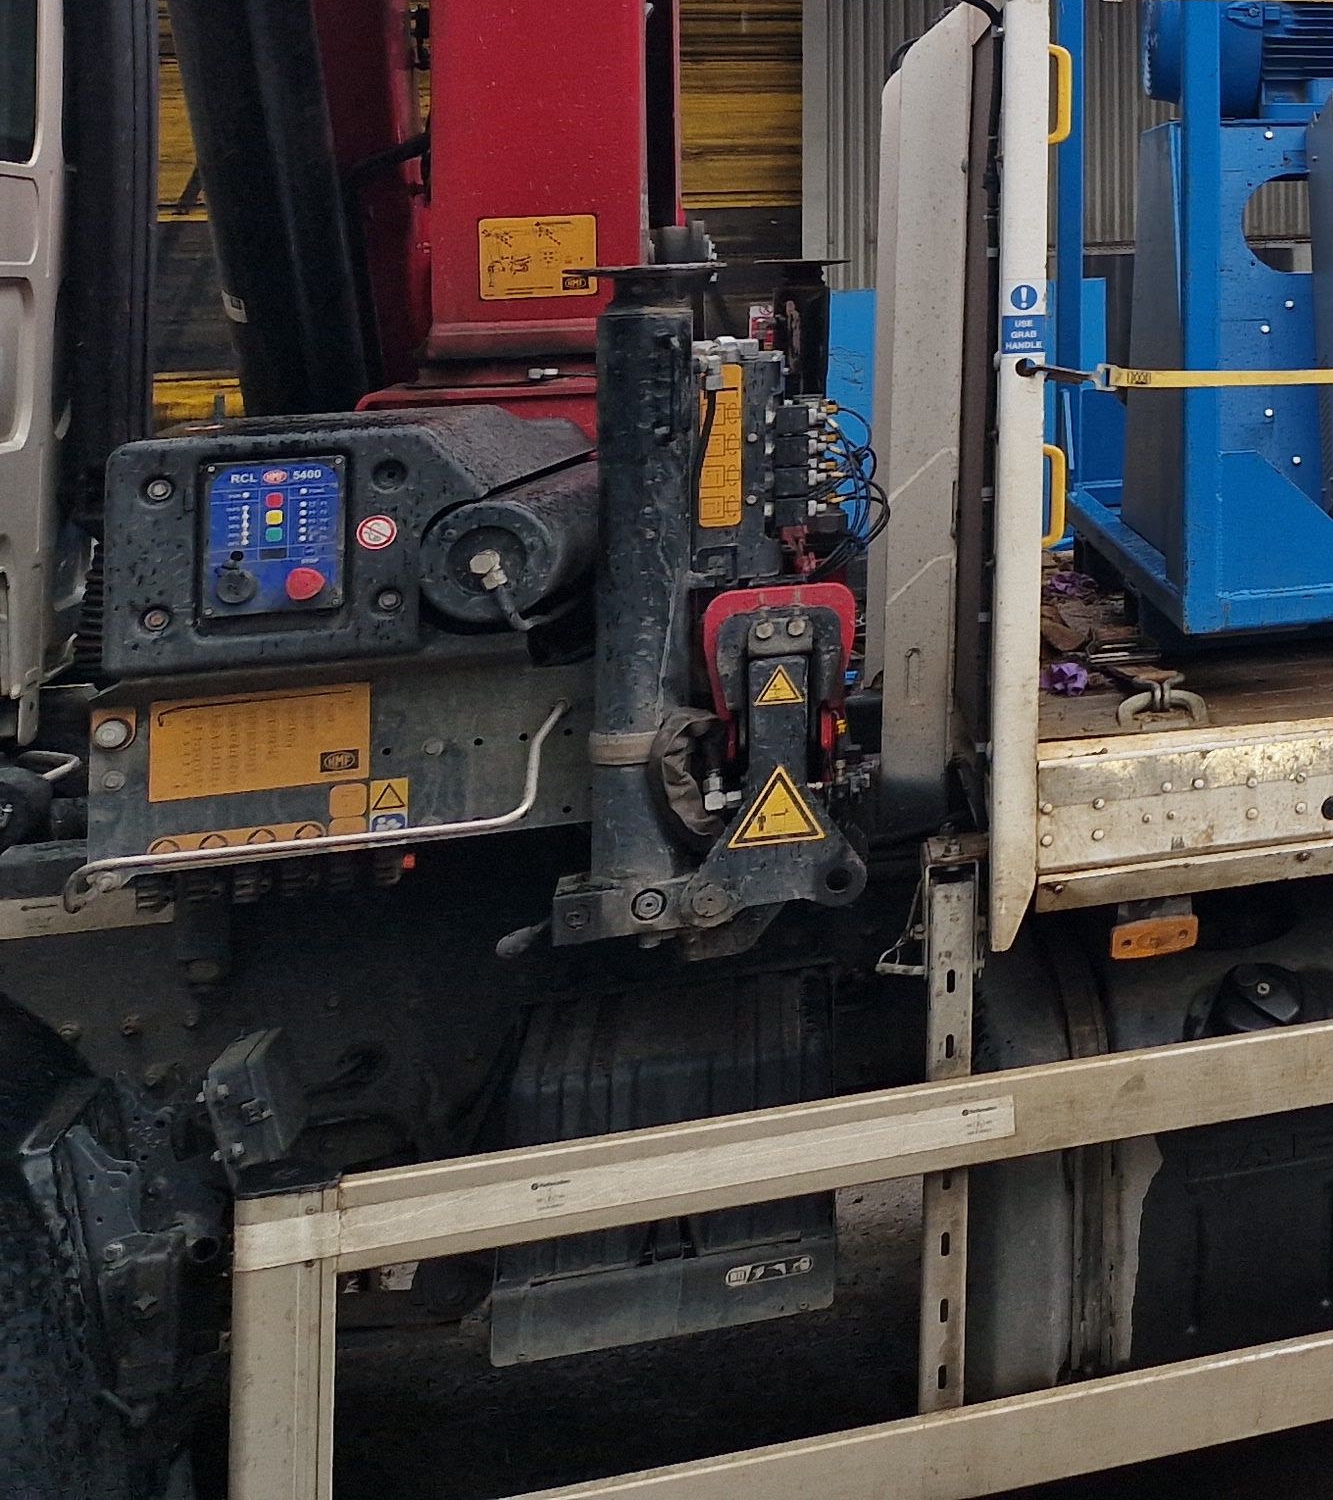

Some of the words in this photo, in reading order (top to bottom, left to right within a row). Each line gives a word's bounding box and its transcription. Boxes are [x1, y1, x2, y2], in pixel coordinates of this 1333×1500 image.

[1014, 320, 1034, 328] USE
[1010, 330, 1037, 339] GRAB
[1005, 341, 1043, 350] HANDLE
[230, 473, 259, 484] RCL
[293, 469, 322, 480] 5400
[326, 754, 352, 768] HMF
